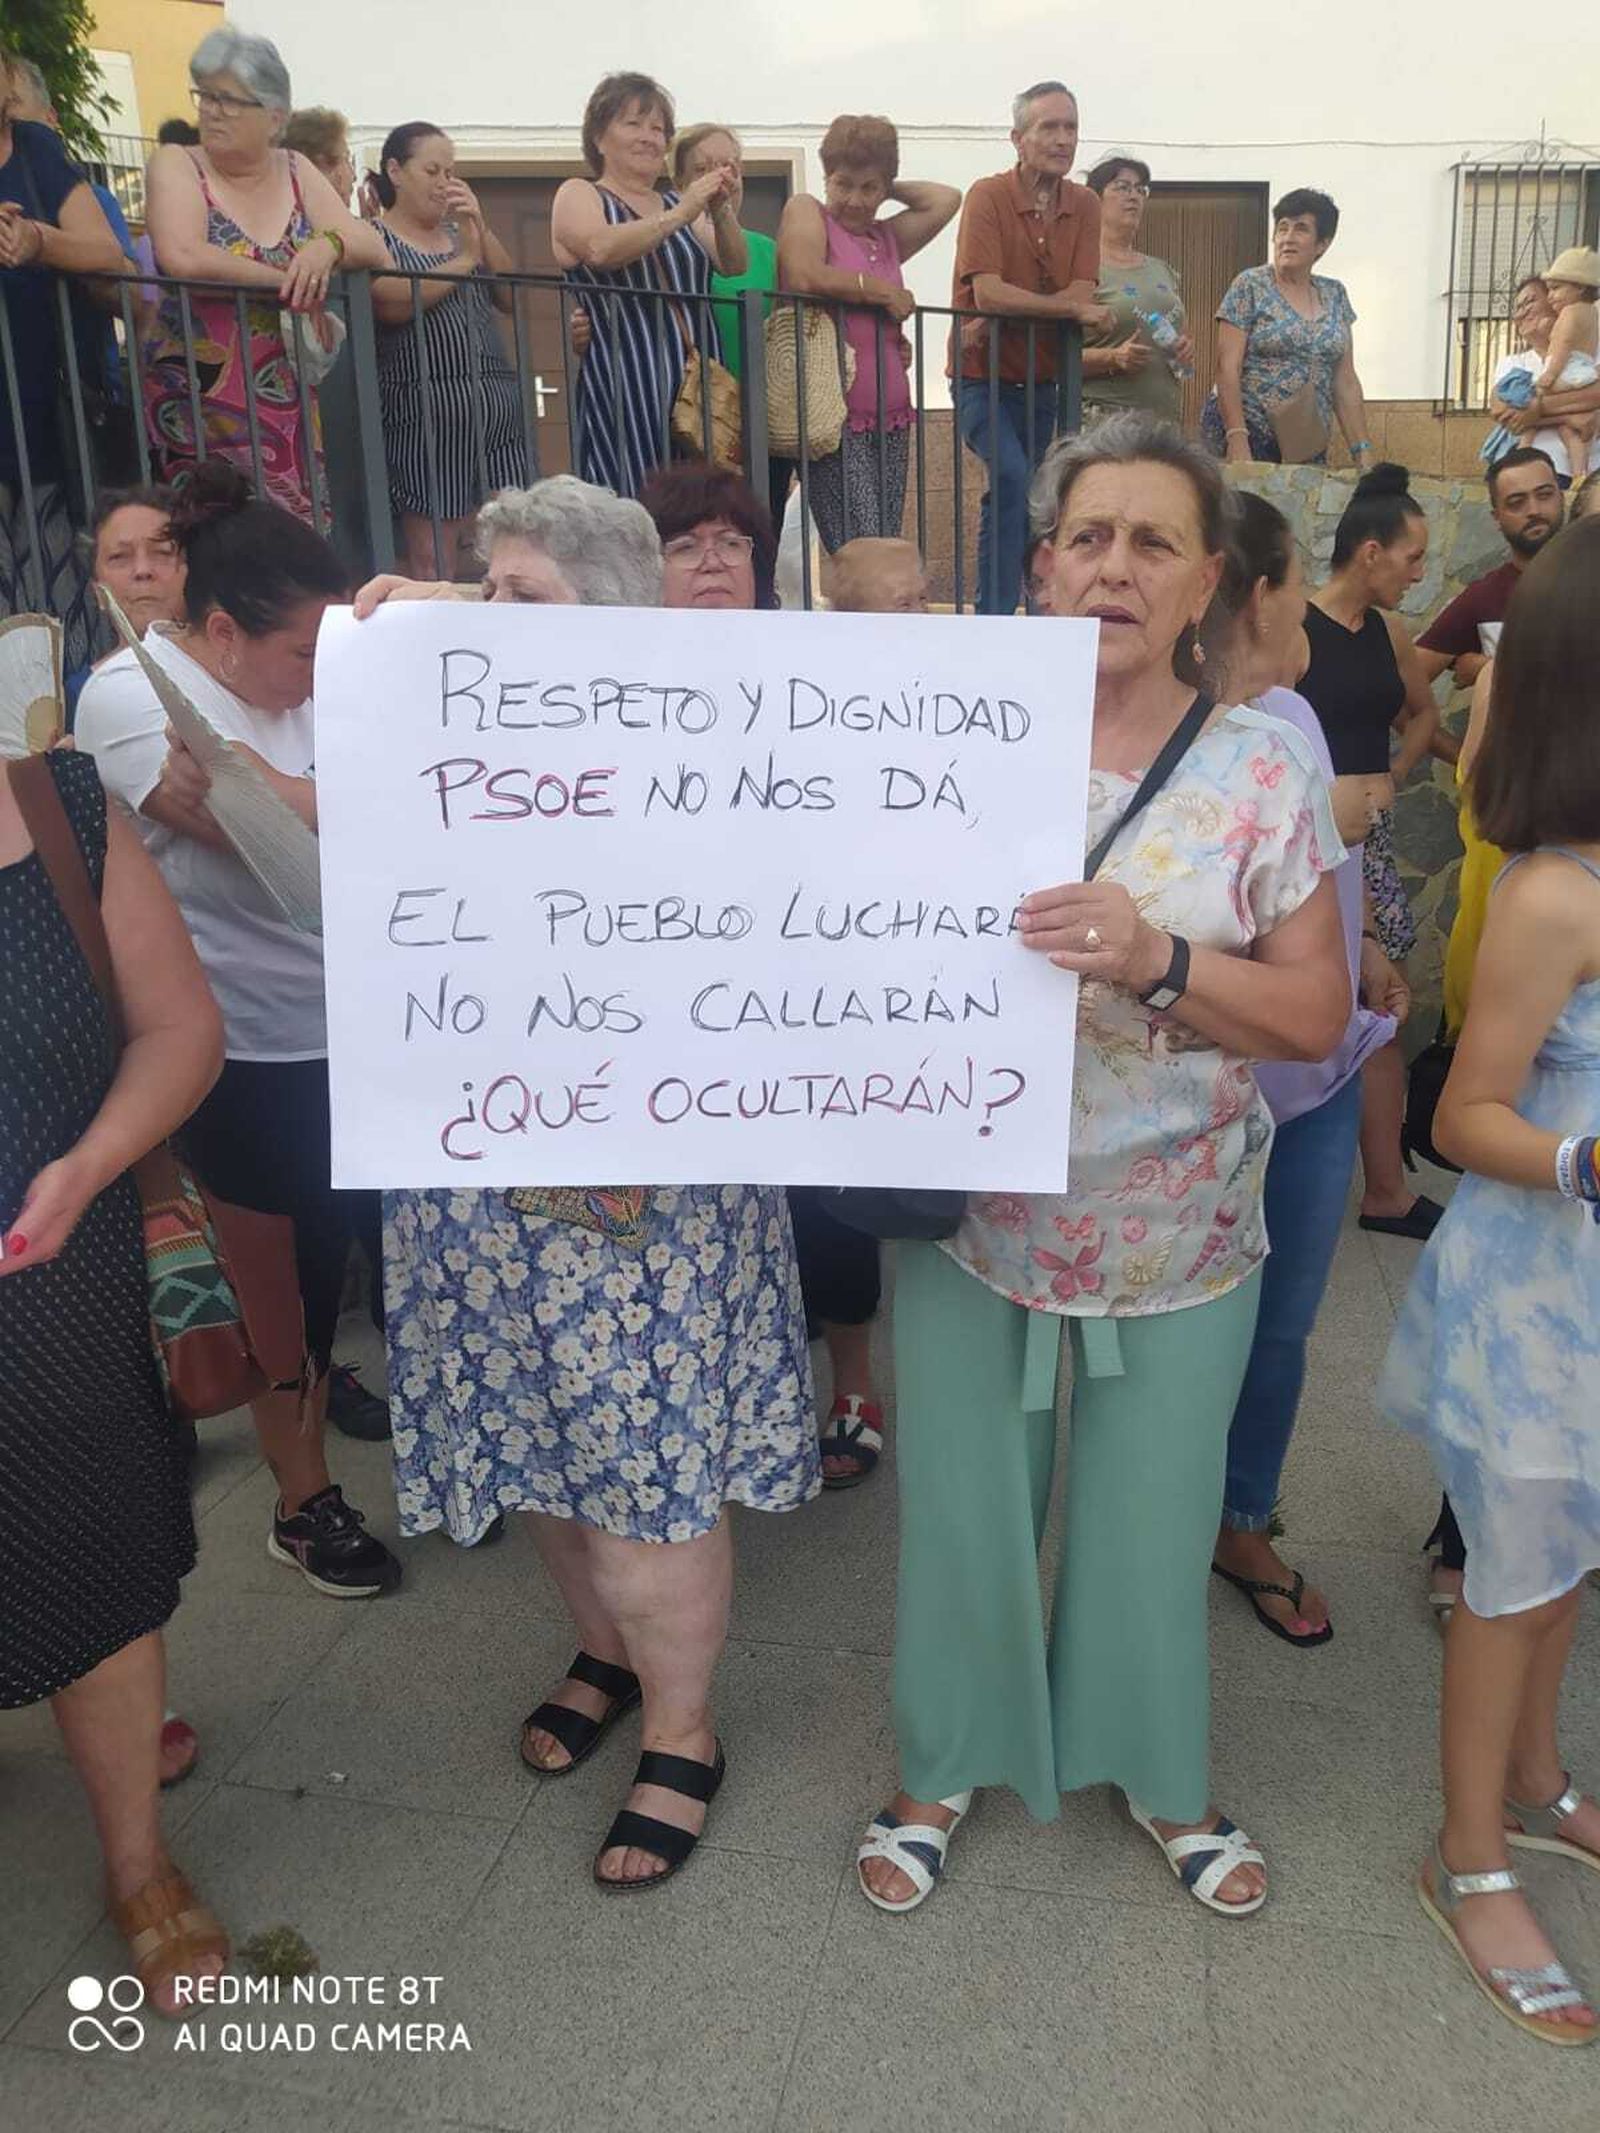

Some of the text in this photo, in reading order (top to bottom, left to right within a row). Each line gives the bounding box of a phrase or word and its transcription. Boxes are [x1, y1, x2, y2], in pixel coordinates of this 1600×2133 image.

[440, 649, 1032, 744] RESPETO Y DIGNIDAD
[419, 758, 620, 831] PSOE
[645, 764, 709, 818] NO
[730, 752, 837, 812] NOS
[387, 889, 492, 948] EL
[535, 890, 754, 948] PUEBLO
[405, 970, 1000, 1042] NO NOS CALLARÁN
[441, 1053, 1027, 1162] ¿QUÉ OCULTARÁN?
